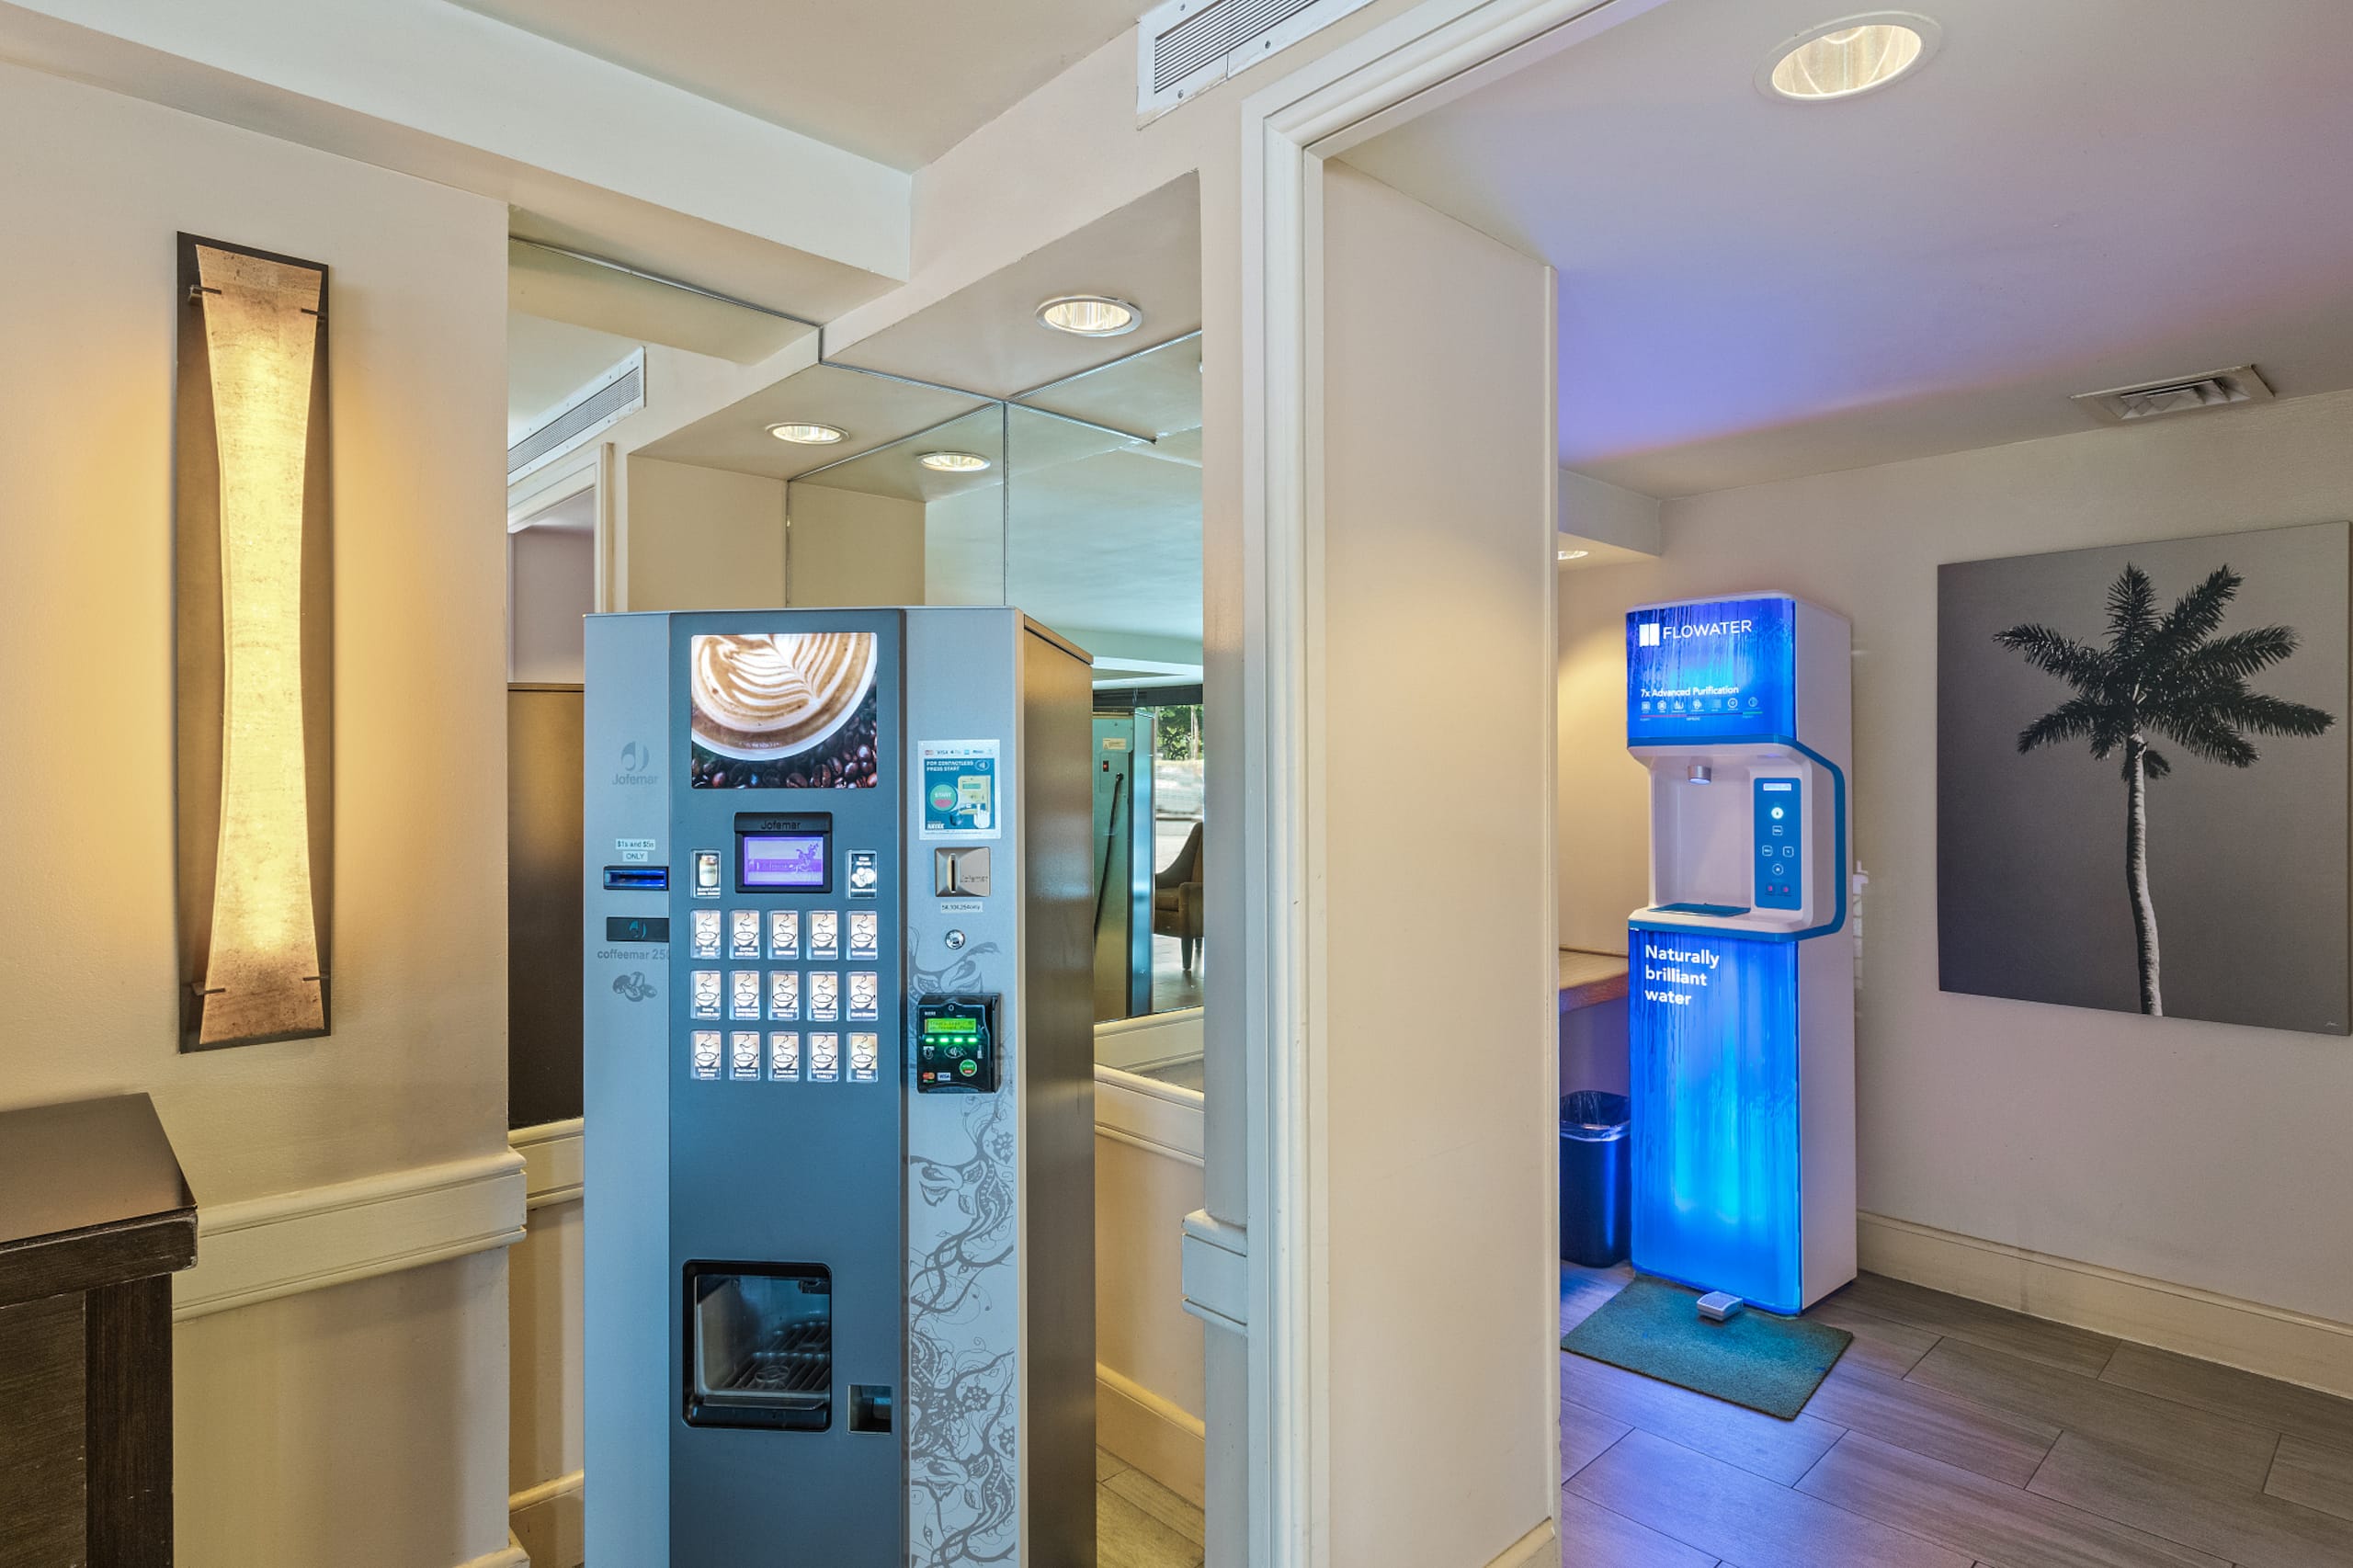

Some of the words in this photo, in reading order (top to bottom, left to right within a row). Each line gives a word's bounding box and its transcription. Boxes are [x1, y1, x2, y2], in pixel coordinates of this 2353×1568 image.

[1663, 619, 1753, 640] FLOWATER
[1652, 687, 1691, 697] Advanced
[1692, 686, 1740, 696] Purification
[612, 773, 659, 786] Jofemar
[761, 820, 801, 830] Jofemar
[597, 949, 650, 960] coffeemar
[1645, 944, 1720, 970] Naturally
[1645, 964, 1708, 986] brilliant
[1644, 990, 1692, 1006] water
